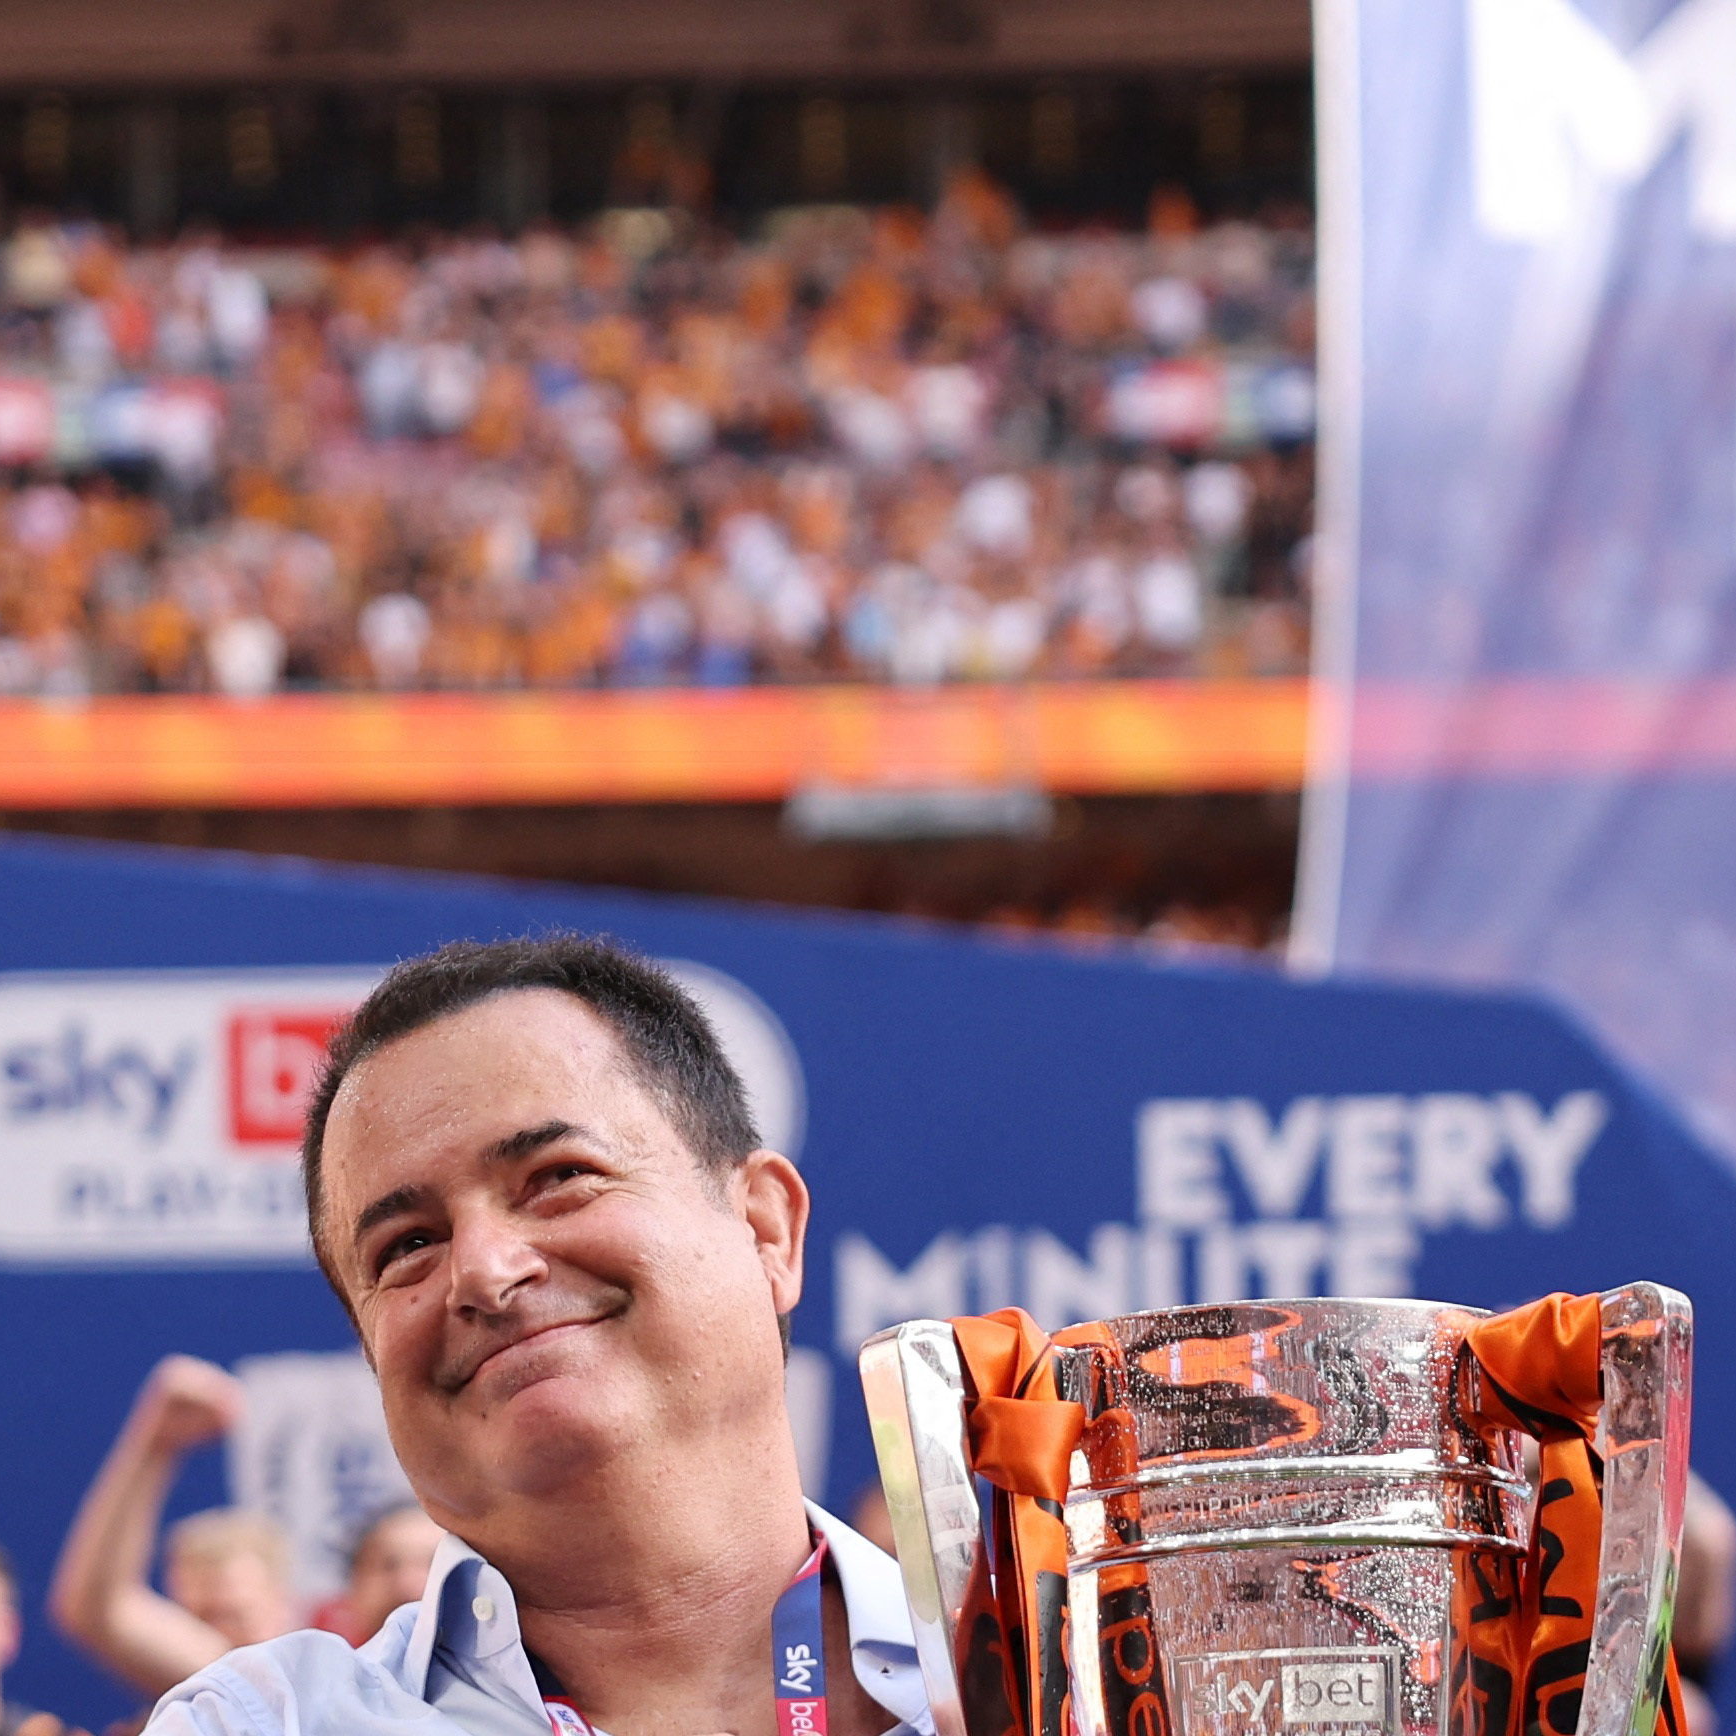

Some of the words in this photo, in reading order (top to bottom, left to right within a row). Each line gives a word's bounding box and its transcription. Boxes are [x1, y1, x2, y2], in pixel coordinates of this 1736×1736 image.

[1134, 1093, 1604, 1231] EVERY
[780, 1644, 818, 1692] sky
[1192, 1671, 1275, 1722] sky
[1293, 1671, 1375, 1708] bet
